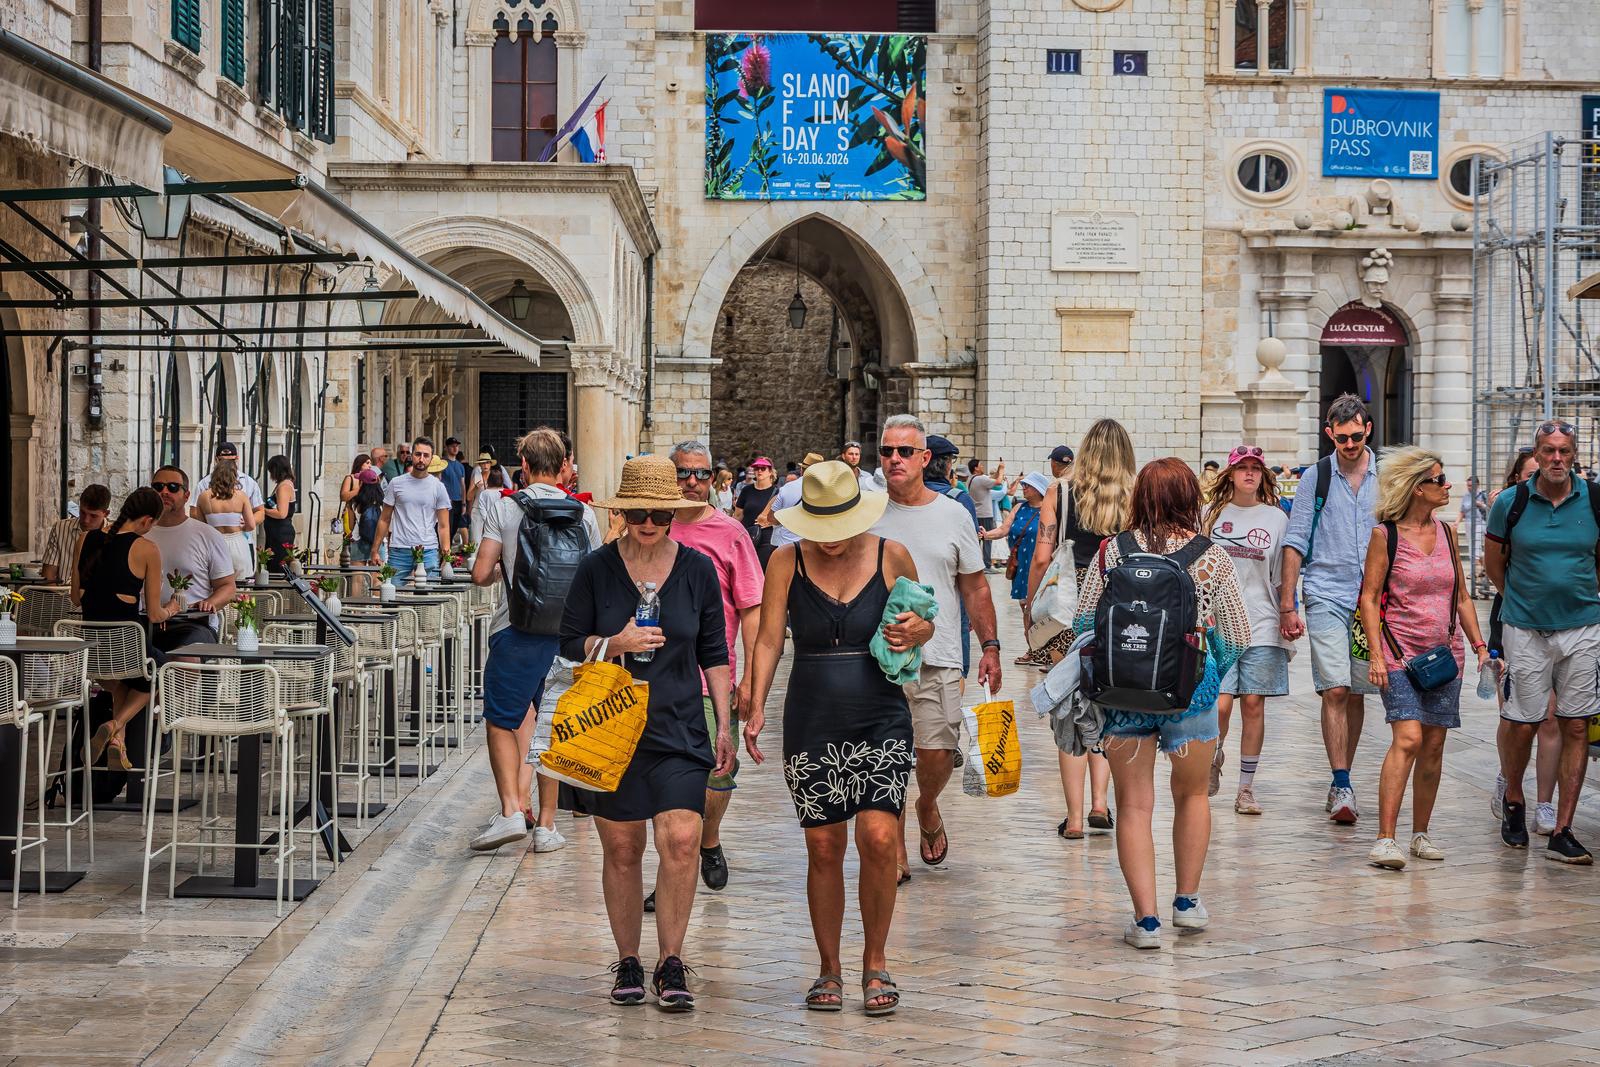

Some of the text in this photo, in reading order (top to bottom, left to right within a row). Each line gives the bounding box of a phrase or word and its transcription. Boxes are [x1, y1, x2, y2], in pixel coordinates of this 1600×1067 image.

[1051, 52, 1075, 72] III
[1122, 53, 1135, 73] 5
[782, 73, 850, 98] SLANO
[1331, 119, 1432, 137] DUBROVNIK
[1330, 139, 1370, 156] PASS
[781, 152, 849, 165] 16-20.06.2026
[1329, 323, 1385, 332] LUŽA CENTAR
[553, 685, 639, 743] BE NOTICED
[554, 755, 576, 770] SHOP
[985, 753, 1003, 776] BE
